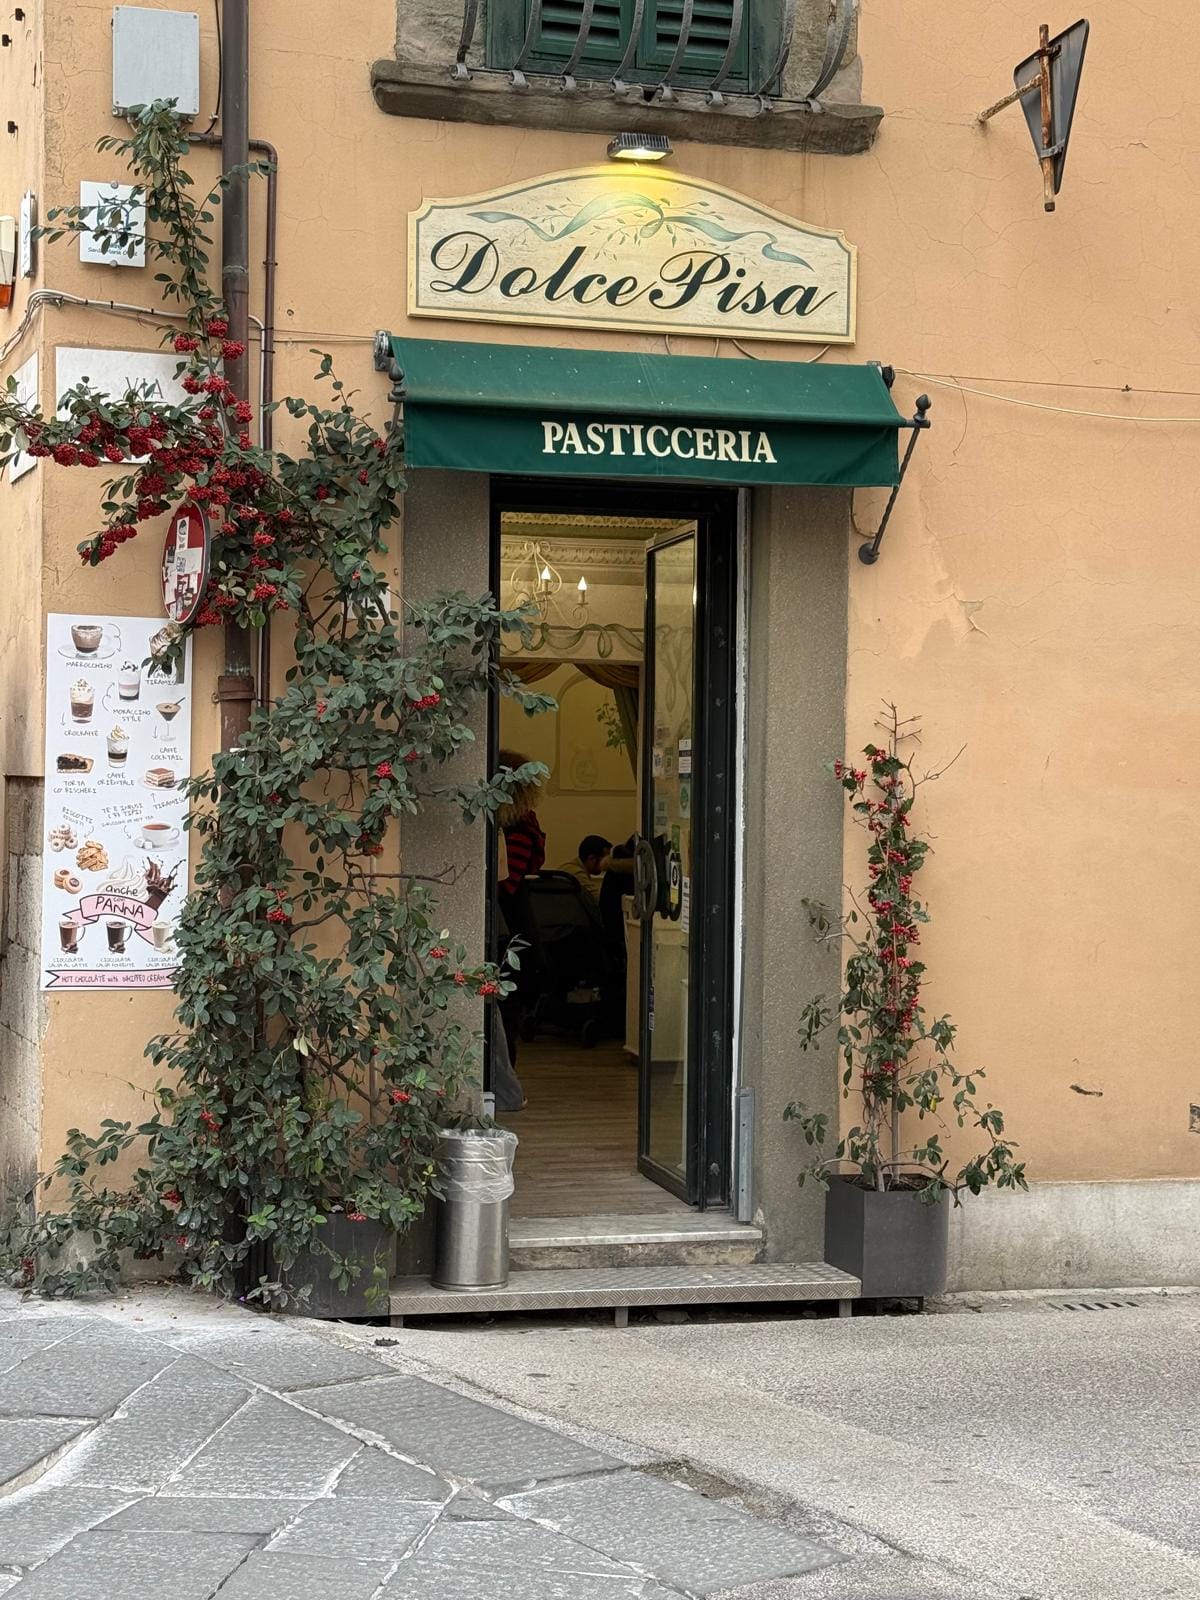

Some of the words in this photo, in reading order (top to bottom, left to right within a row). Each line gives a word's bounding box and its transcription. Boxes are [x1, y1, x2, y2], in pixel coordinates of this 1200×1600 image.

[429, 230, 657, 308] Dolce
[648, 249, 839, 318] Pisa
[541, 421, 778, 464] PASTICCERIA
[62, 806, 94, 824] BISCOTTI
[105, 884, 138, 896] anche
[95, 895, 144, 918] PANNA
[74, 975, 106, 983] CHOCOLATE
[146, 975, 166, 983] CREAM
